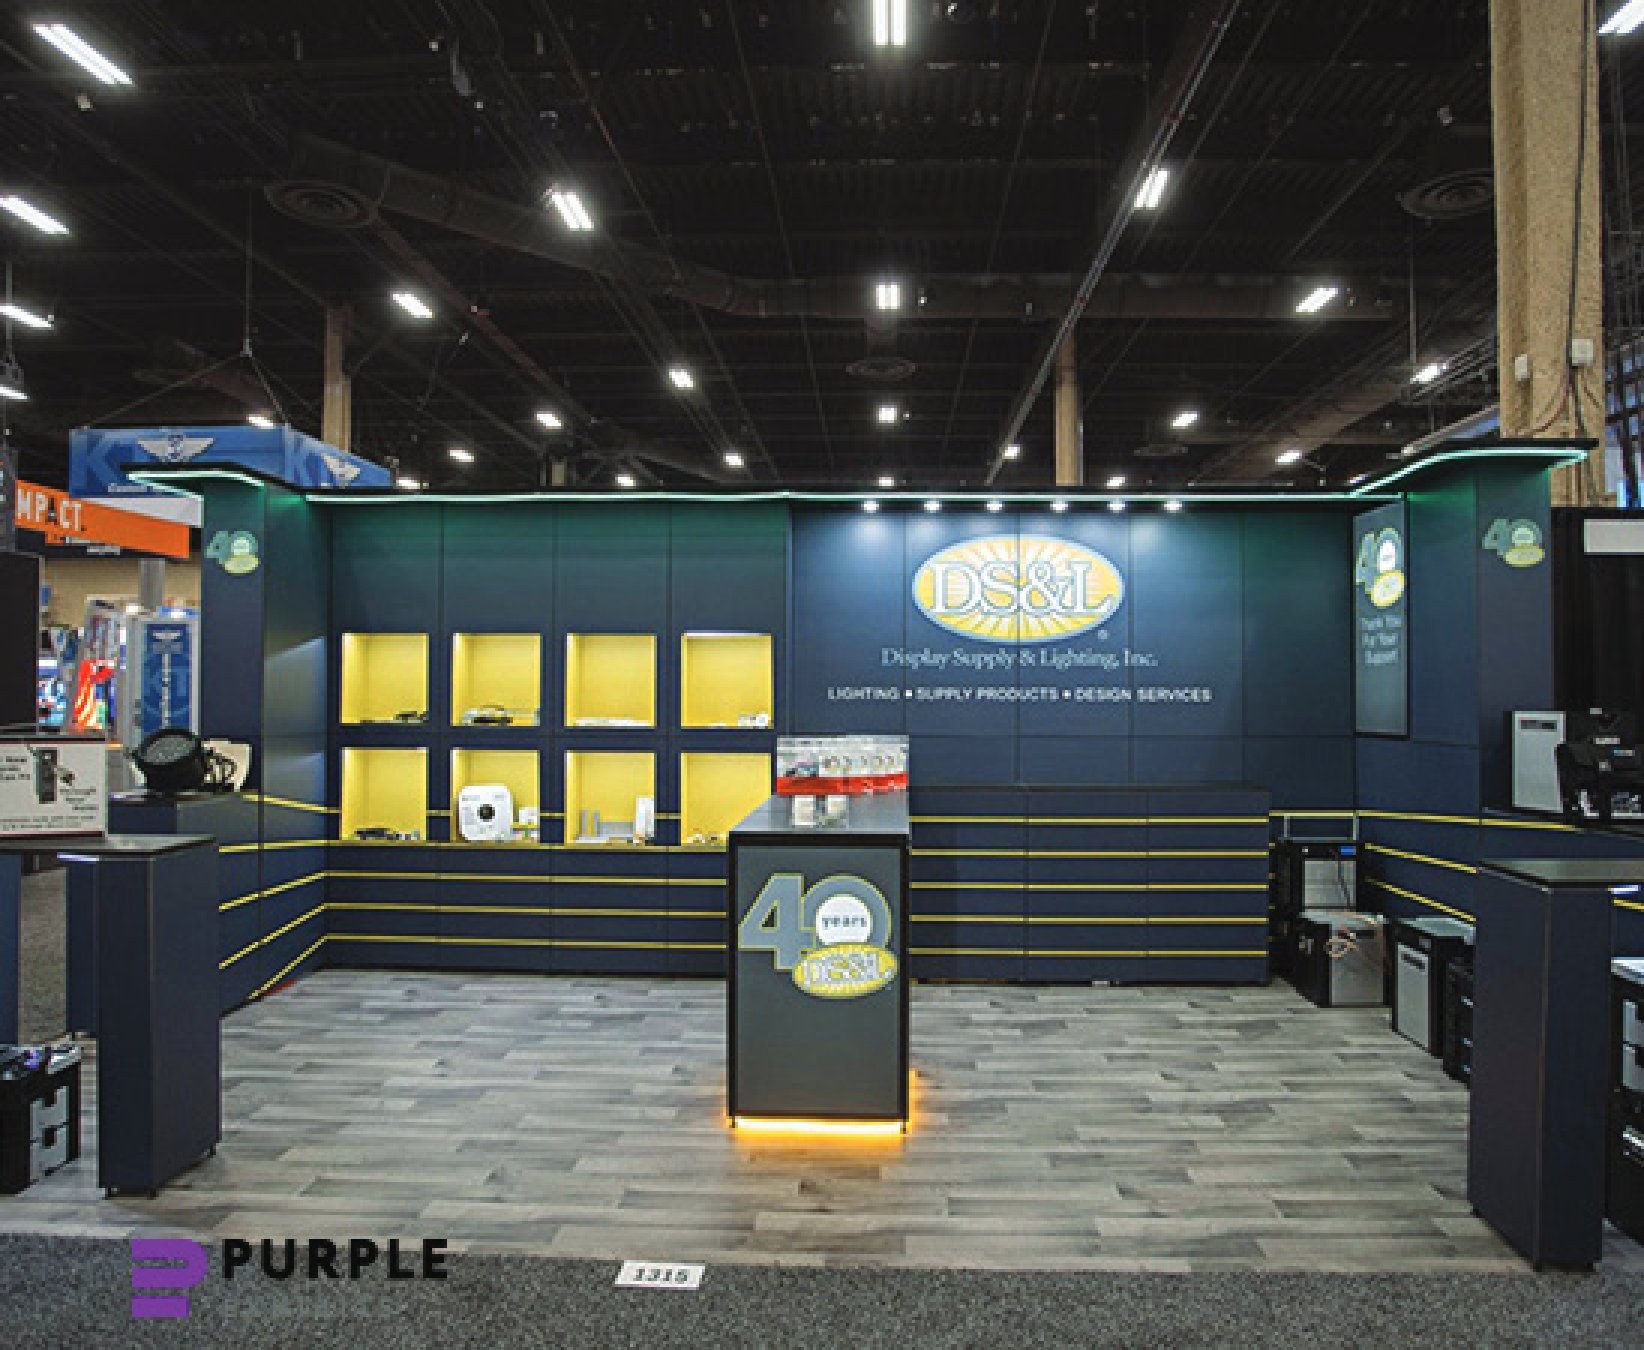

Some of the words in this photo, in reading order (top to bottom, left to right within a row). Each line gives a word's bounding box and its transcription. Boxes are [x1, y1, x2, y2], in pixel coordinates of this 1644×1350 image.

[931, 561, 1115, 615] DS&L
[881, 648, 949, 669] Display
[954, 648, 1017, 669] Supply
[1020, 650, 1036, 667] &
[1123, 648, 1158, 667] Inc.
[827, 686, 899, 701] LIGHTING
[914, 686, 973, 701] SUPPLY
[977, 686, 1059, 701] PRODUCTS
[1073, 686, 1132, 701] DESIGN
[1136, 686, 1213, 701] SERVICES
[738, 873, 891, 972] 40
[821, 916, 867, 930] years
